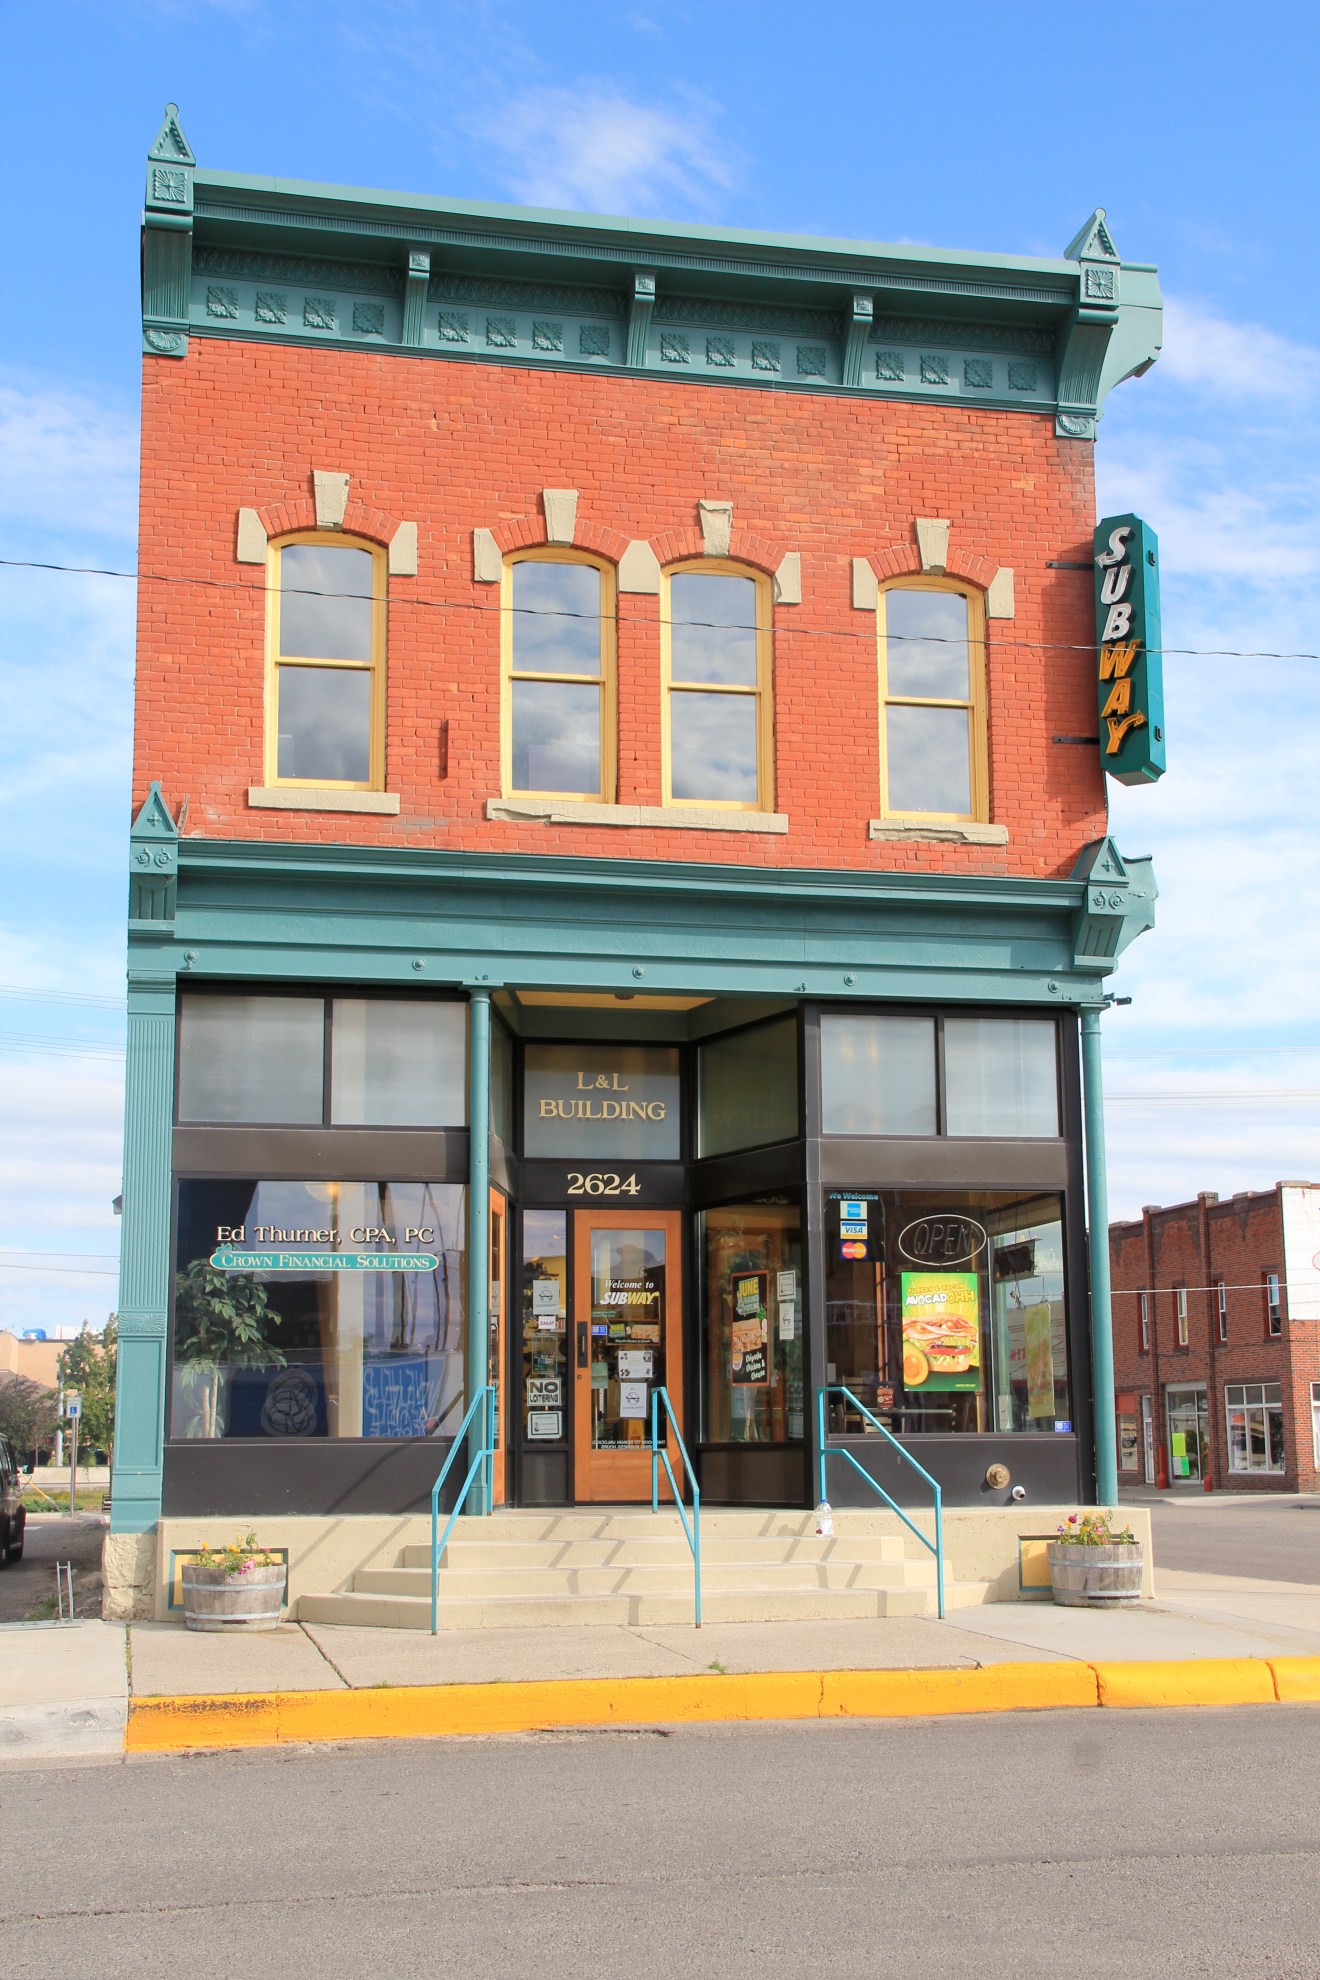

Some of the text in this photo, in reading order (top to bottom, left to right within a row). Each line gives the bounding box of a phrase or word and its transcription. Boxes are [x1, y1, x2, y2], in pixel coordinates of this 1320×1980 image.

[1094, 526, 1148, 755] SUBWAY
[538, 1099, 667, 1120] BUILDING
[566, 1172, 642, 1195] 2624
[216, 1225, 435, 1244] Ed Thurner, CPA, PC
[845, 1226, 864, 1234] VISA
[913, 1223, 974, 1255] OPEN
[279, 1254, 351, 1267] FINANCIAL
[356, 1255, 430, 1269] SOLUTIONS
[605, 1279, 655, 1289] Welcome to
[736, 1277, 759, 1297] JUNE
[599, 1291, 660, 1305] SUBWAY
[529, 1381, 559, 1394] NO
[529, 1393, 559, 1403] LOITERING
